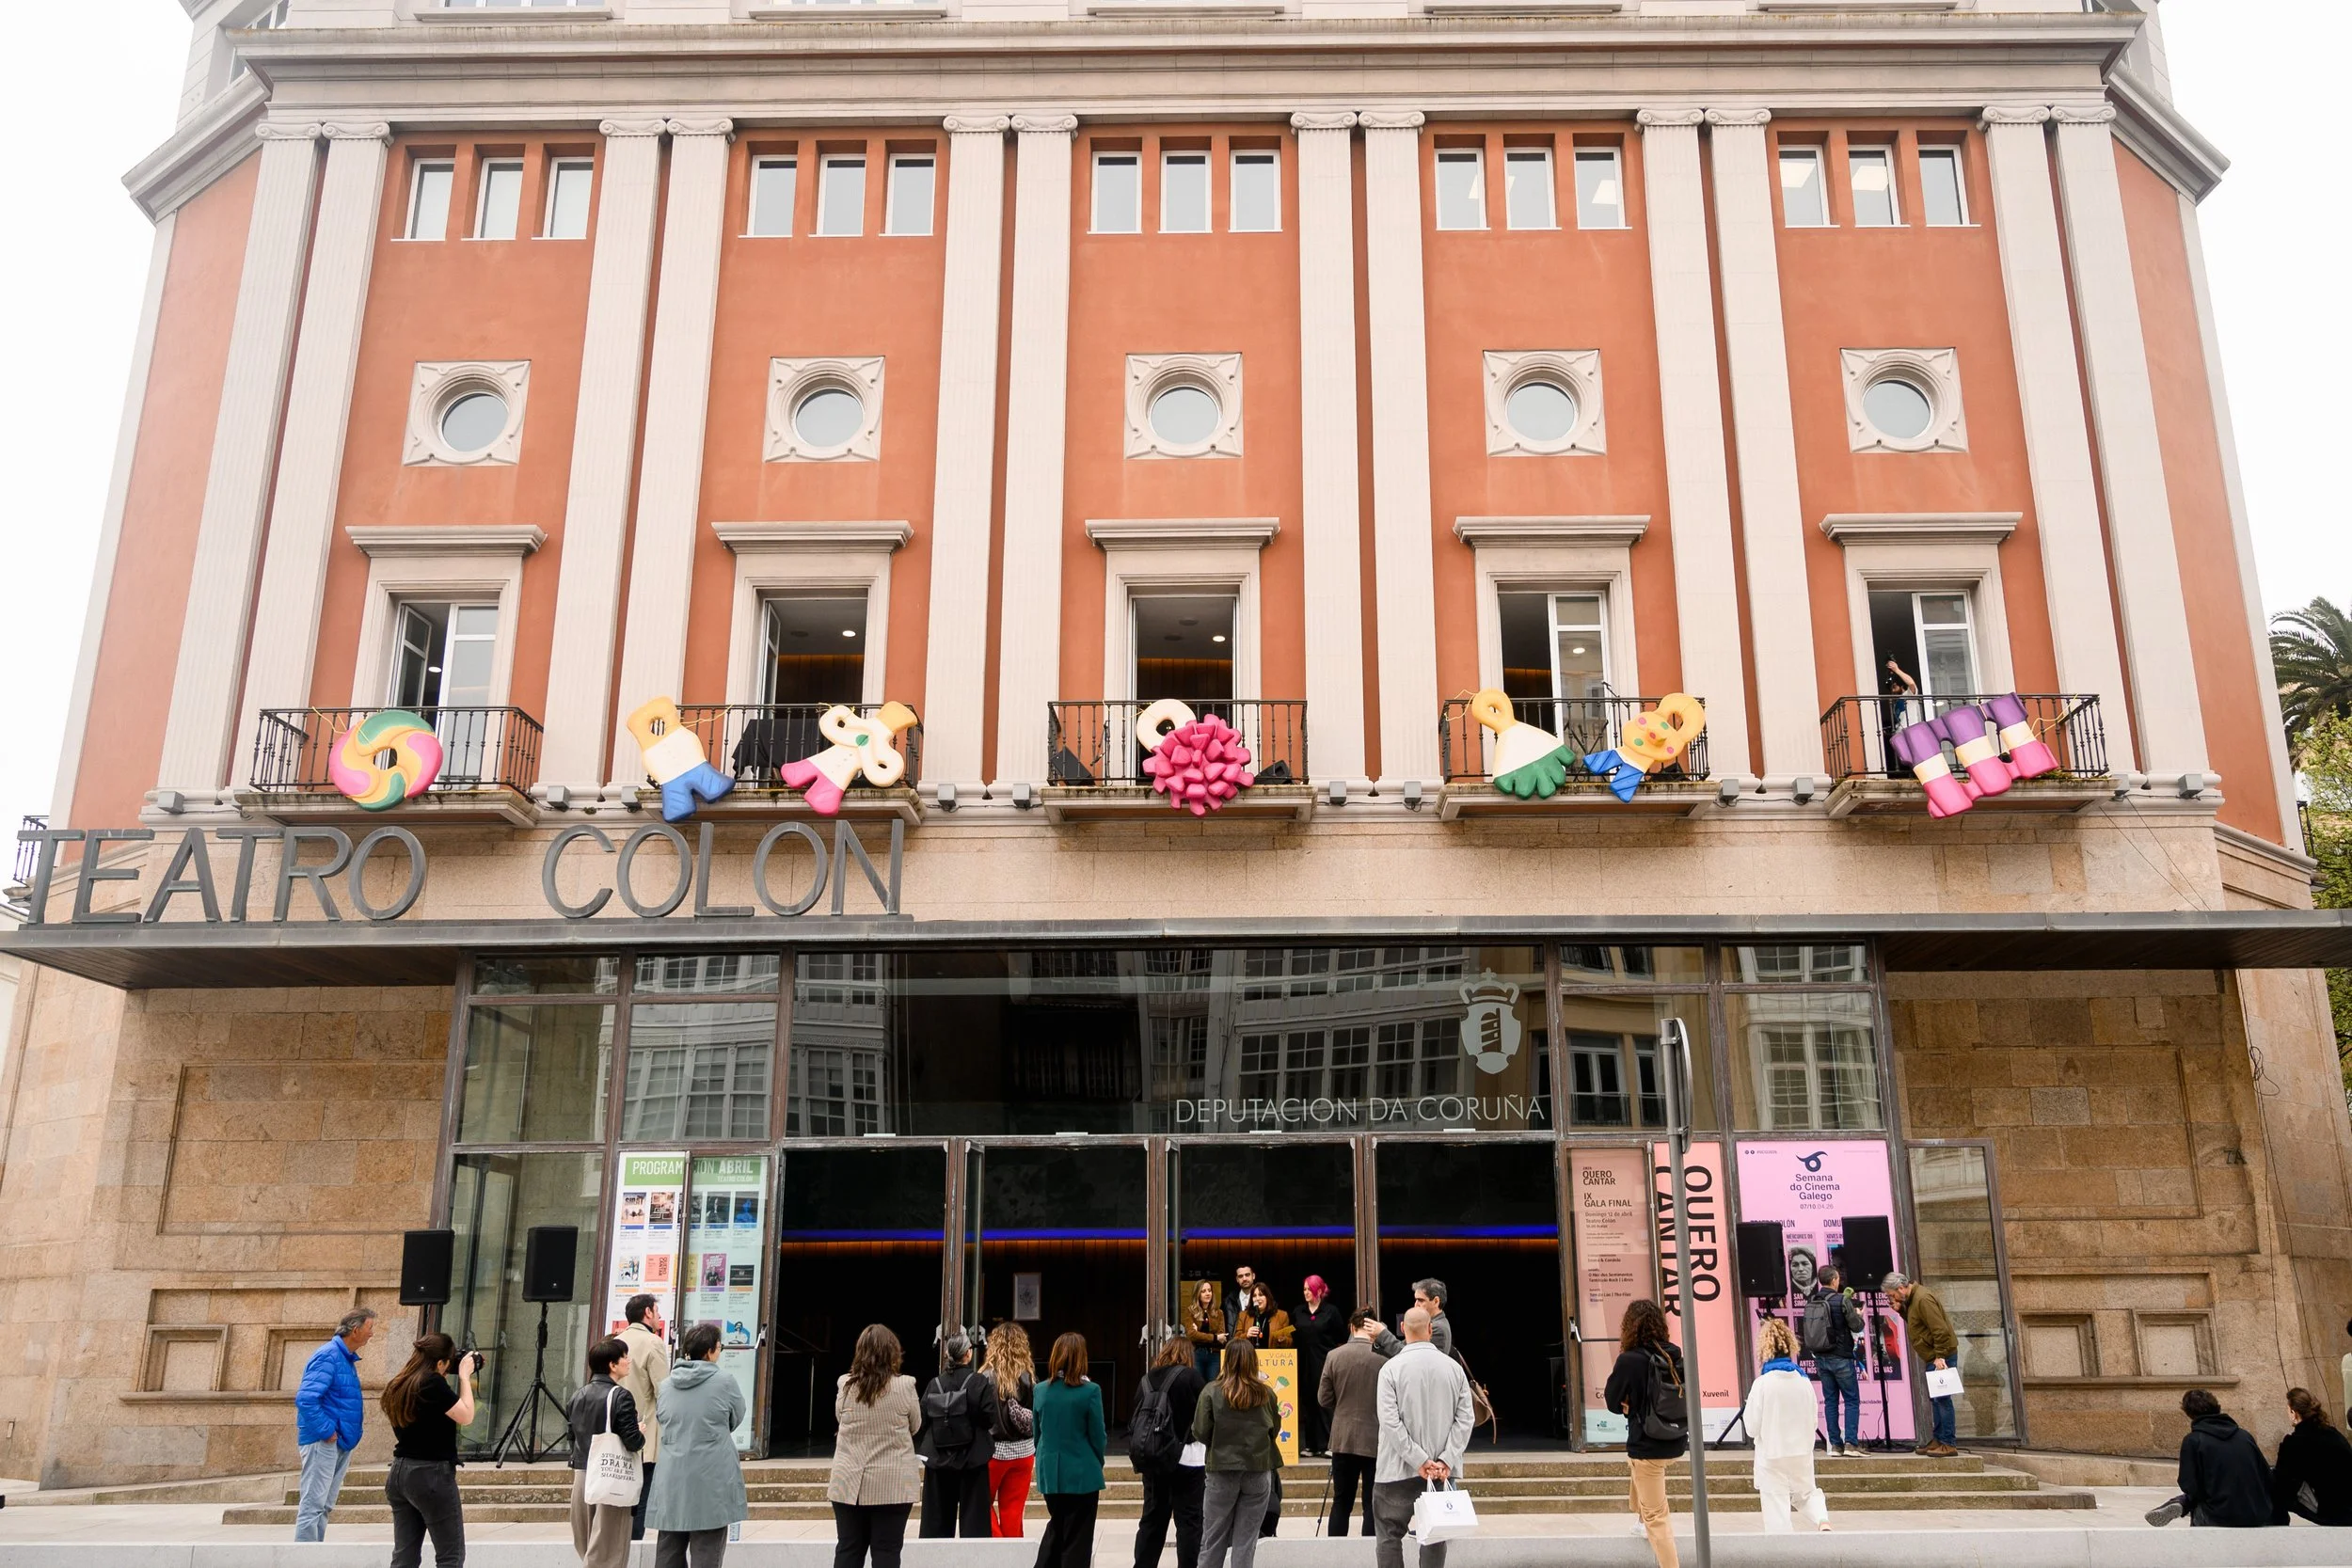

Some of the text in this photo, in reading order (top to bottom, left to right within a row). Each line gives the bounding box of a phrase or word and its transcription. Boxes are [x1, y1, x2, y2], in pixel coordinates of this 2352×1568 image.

[17, 818, 904, 923] TEATRO COLON
[1176, 1093, 1544, 1123] DEPUTACION DA CORUÑA
[632, 1159, 754, 1175] PROGRAMIÓN ABRIL
[1582, 1170, 1613, 1180] QUERO
[1795, 1174, 1834, 1182] Semana
[1582, 1178, 1616, 1186] CANTAR
[1583, 1192, 1592, 1200] IX
[1799, 1192, 1833, 1202] Galego
[1584, 1199, 1607, 1208] GALA
[1823, 1219, 1843, 1227] DOMU
[600, 1459, 634, 1470] DRAMA
